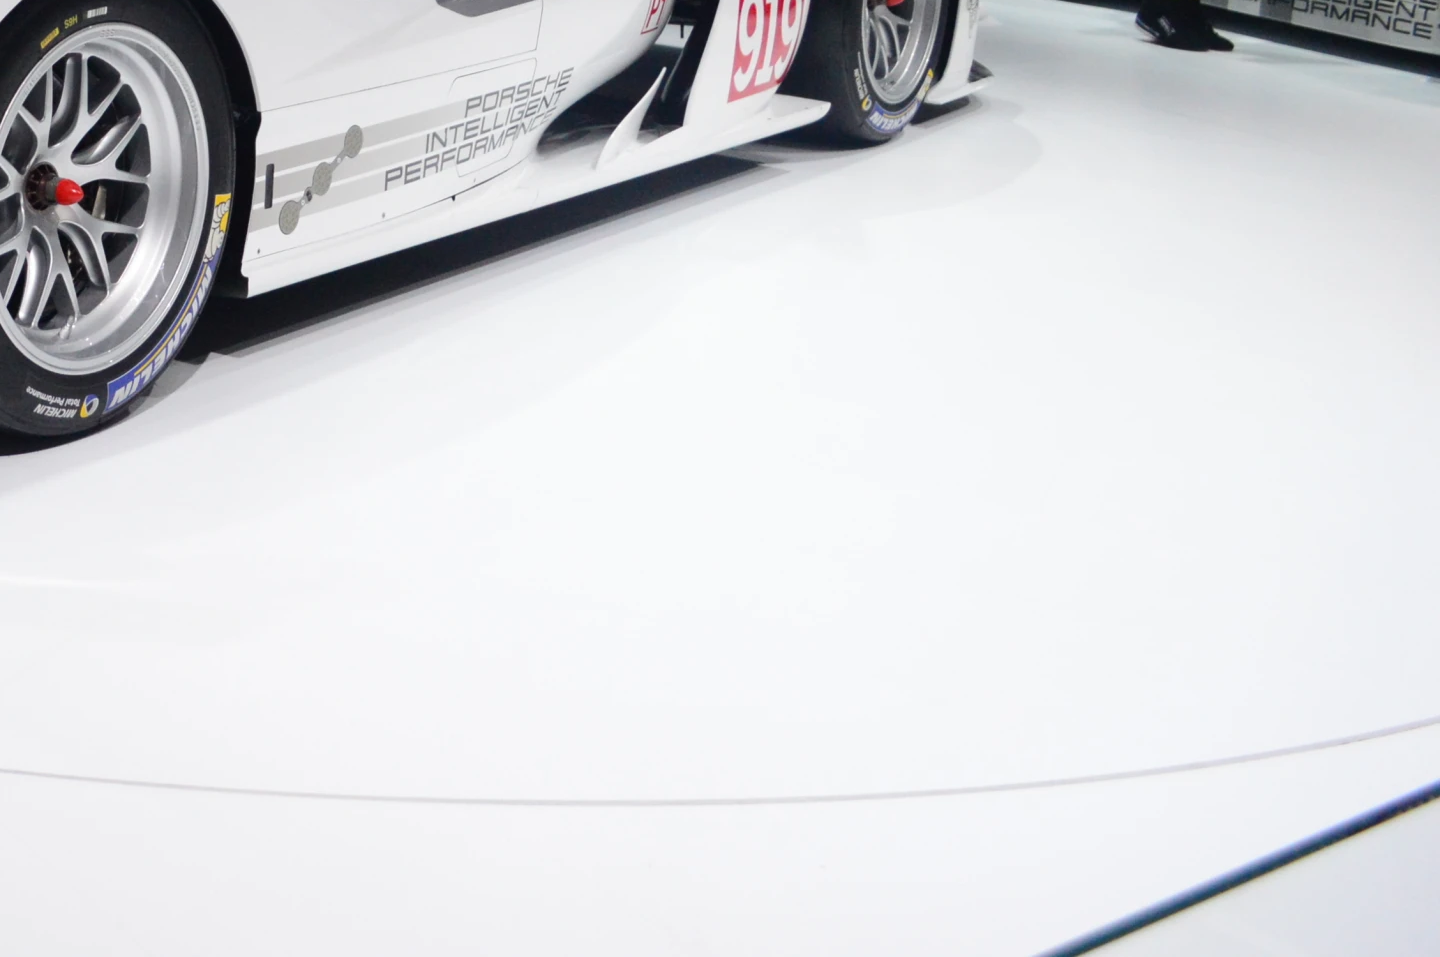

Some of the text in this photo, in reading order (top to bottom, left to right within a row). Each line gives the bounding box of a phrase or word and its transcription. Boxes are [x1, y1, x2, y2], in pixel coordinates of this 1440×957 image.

[425, 87, 567, 154] INTELLIGENT
[464, 66, 575, 118] PORSCHE
[384, 106, 557, 192] PERFORMANCE
[110, 264, 214, 409] MICHELIN
[33, 402, 78, 419] MICHELIN
[66, 398, 81, 407] Total
